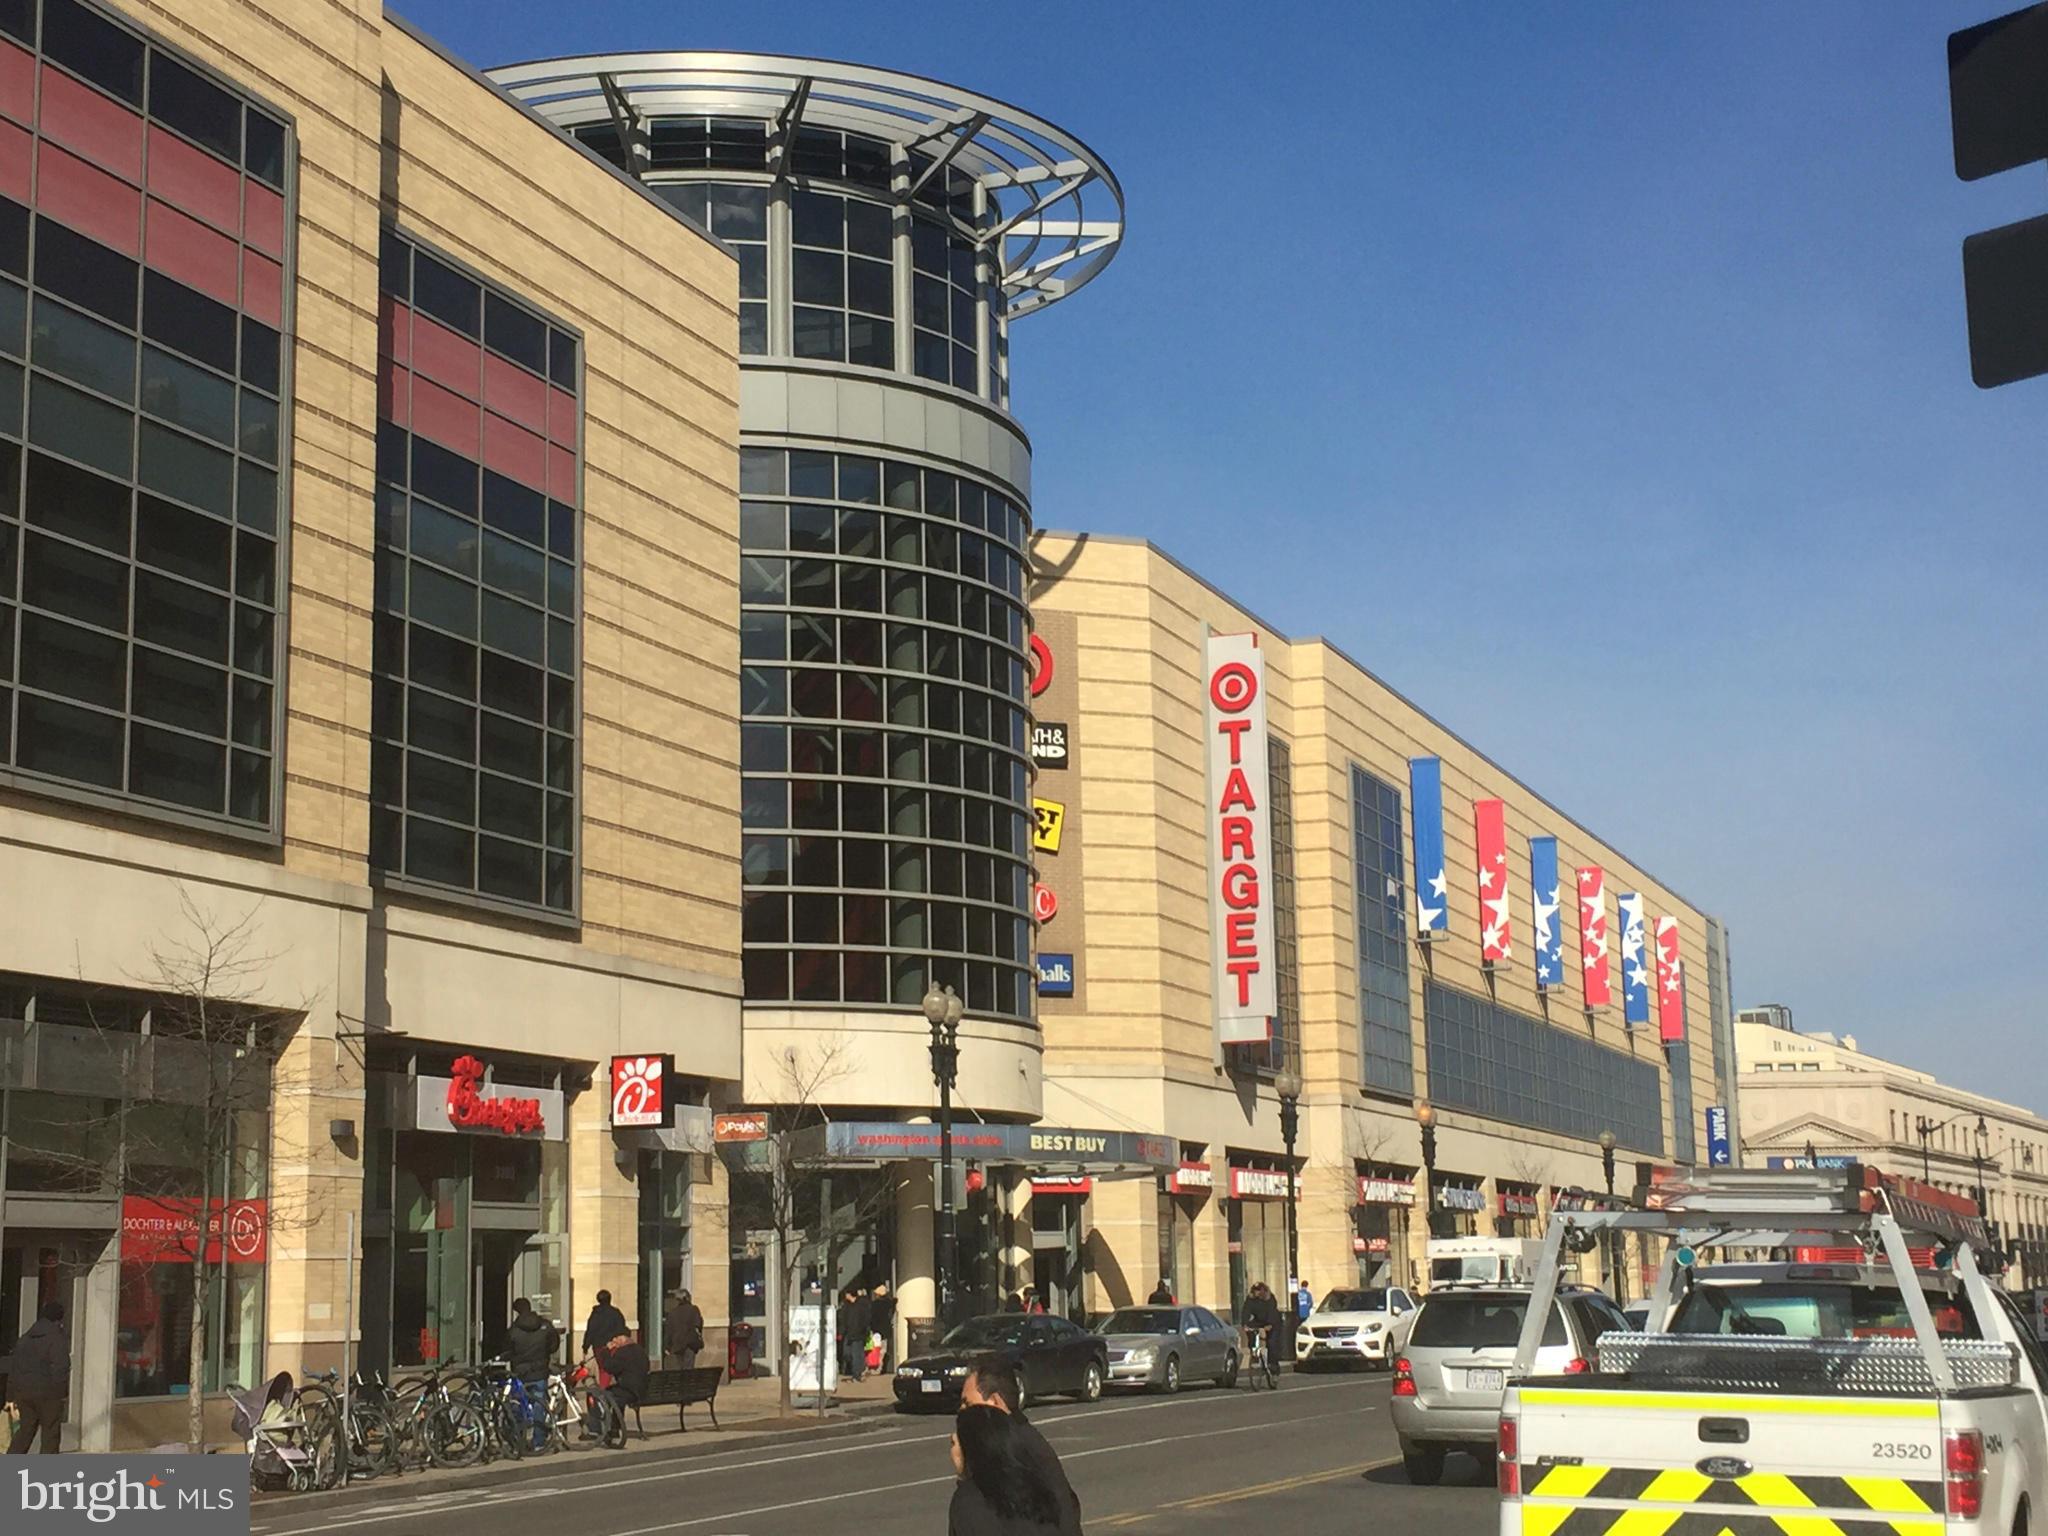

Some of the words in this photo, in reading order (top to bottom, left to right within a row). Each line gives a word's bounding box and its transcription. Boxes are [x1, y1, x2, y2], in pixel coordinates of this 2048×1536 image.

[1038, 827, 1052, 840] Y
[1218, 718, 1260, 1007] TARGET
[1712, 1107, 1726, 1141] PARK
[1030, 1134, 1074, 1151] BEST
[1075, 1136, 1107, 1153] BUY
[123, 1218, 165, 1231] DOCHTER
[1872, 1442, 1932, 1460] 23520
